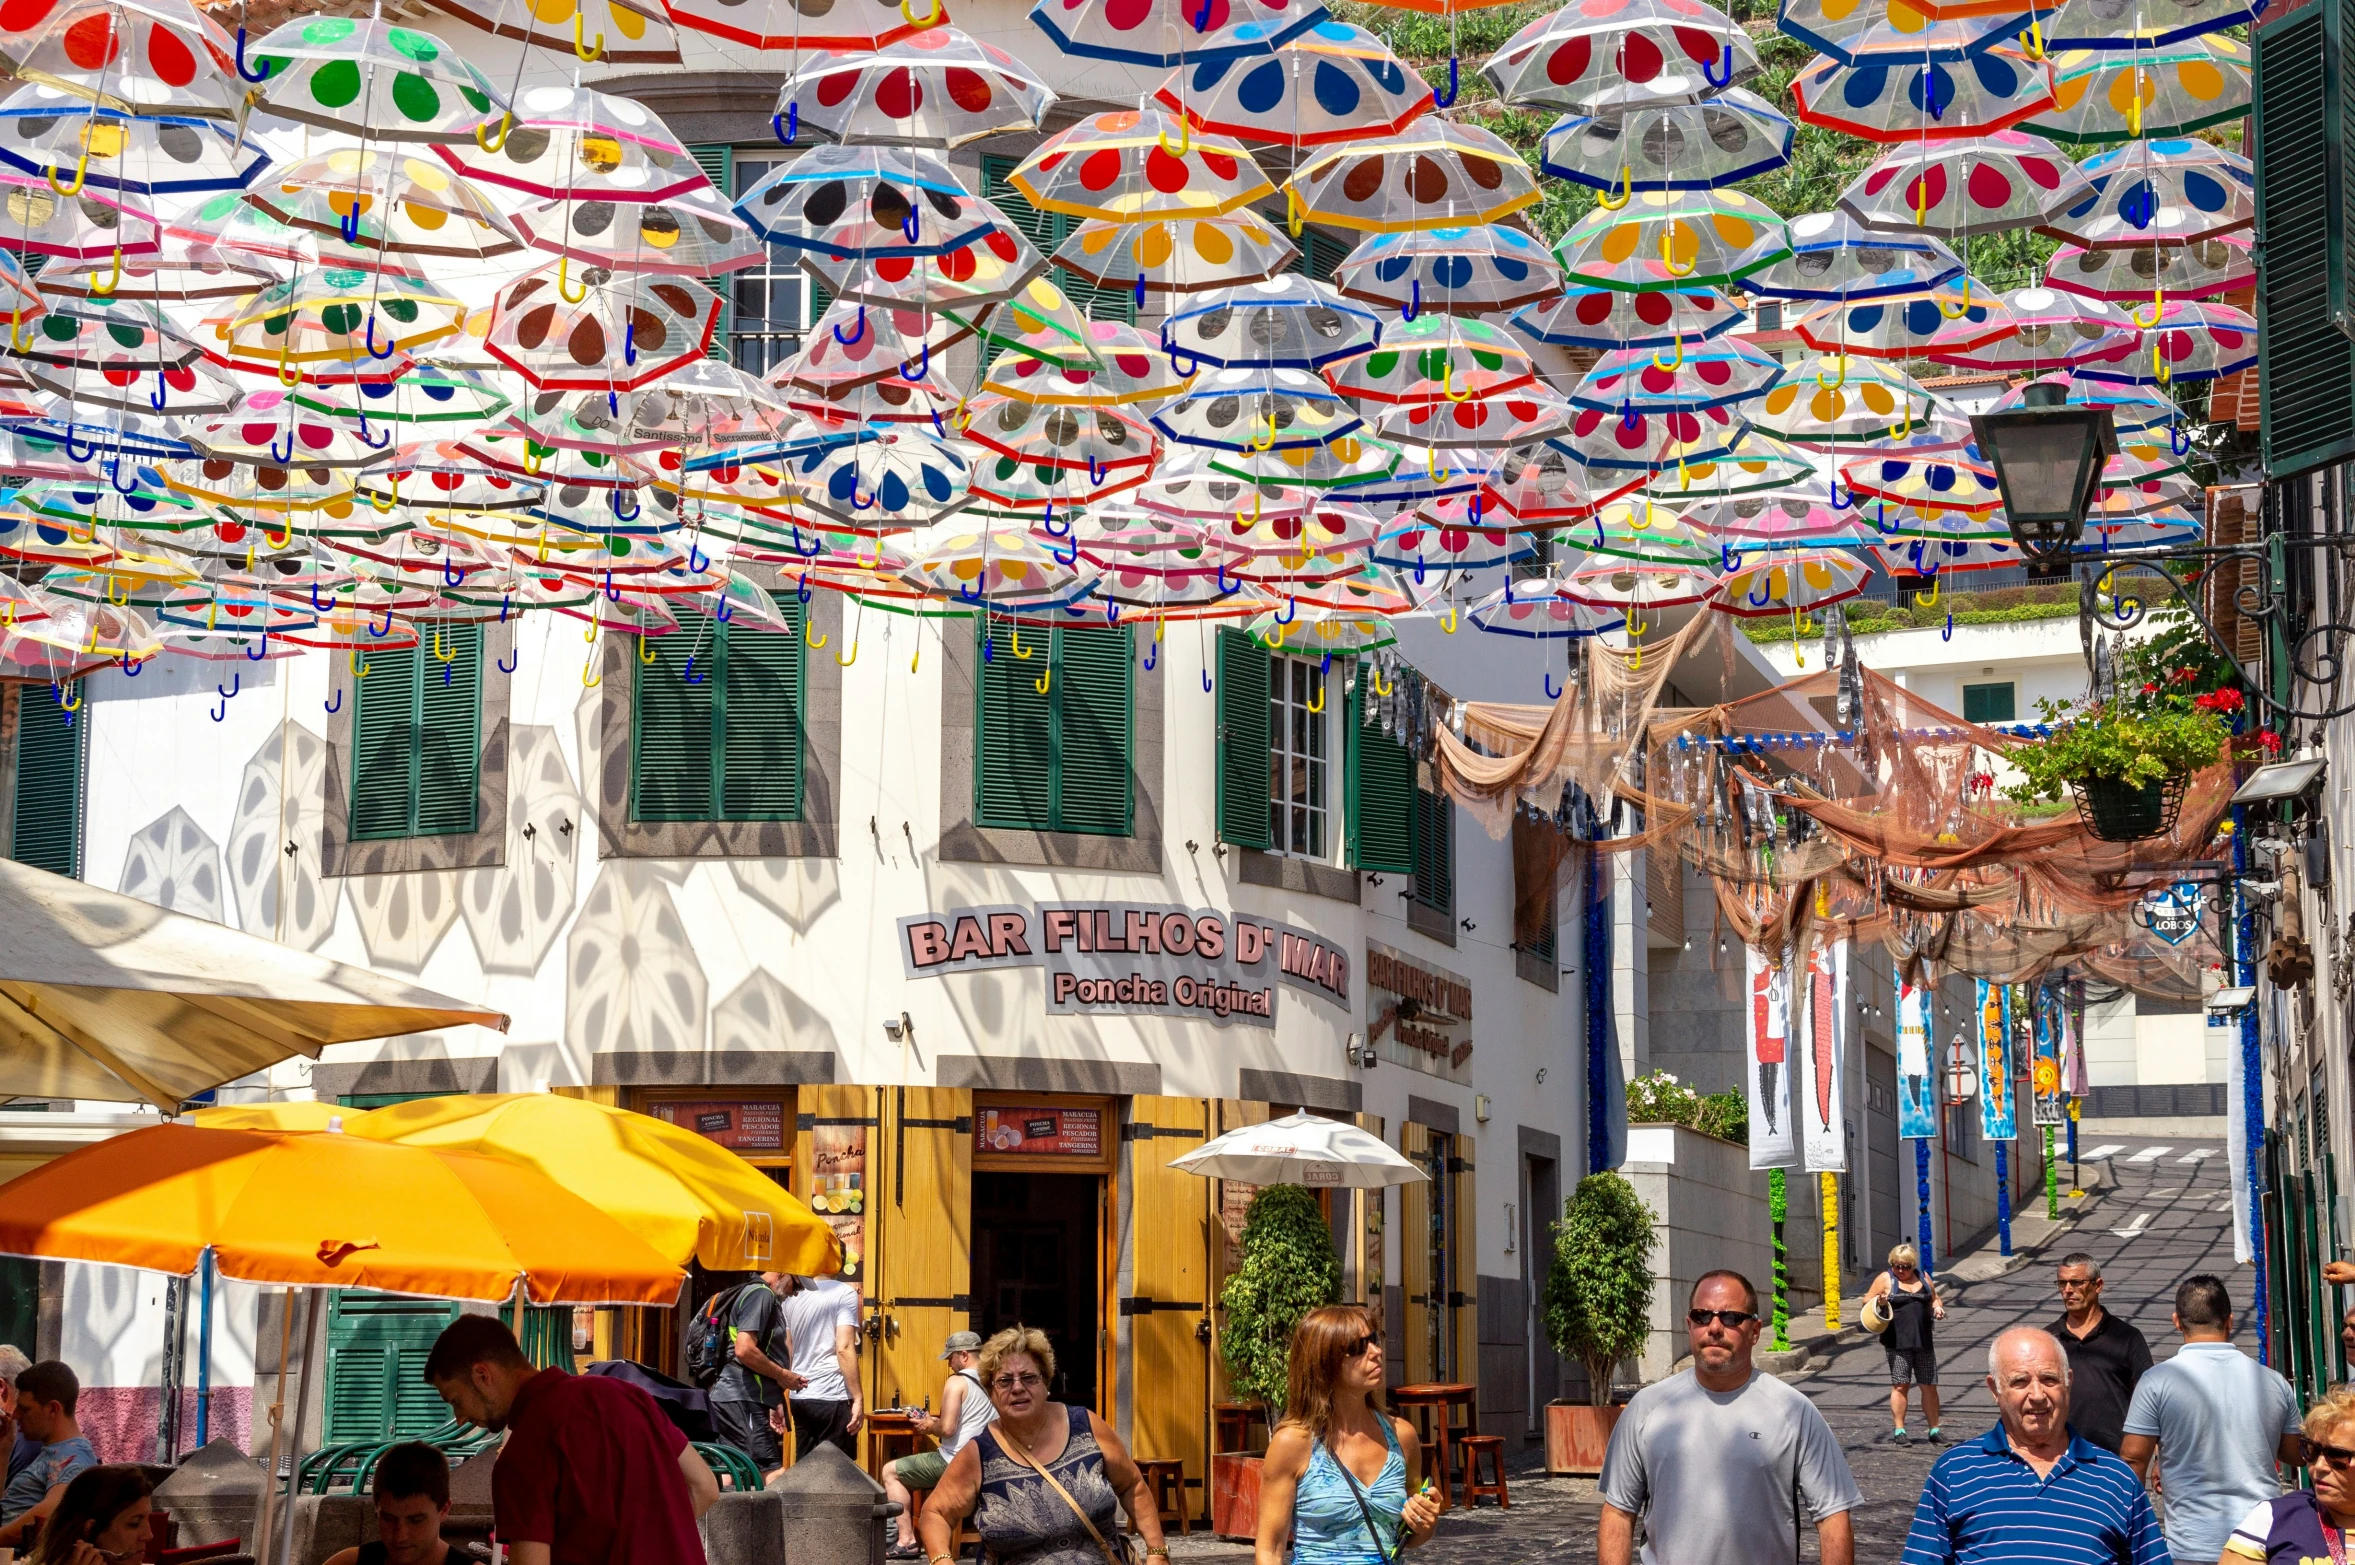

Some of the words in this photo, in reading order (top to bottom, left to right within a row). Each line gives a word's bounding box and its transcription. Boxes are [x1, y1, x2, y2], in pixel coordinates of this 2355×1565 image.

[591, 415, 610, 430] DO
[714, 431, 772, 443] Sacramento
[2156, 920, 2192, 930] LOBOS
[906, 912, 1033, 968] BAR
[1043, 910, 1225, 959] FILHOS
[1236, 921, 1274, 965] D'
[1281, 931, 1347, 1000] MAR
[1053, 972, 1170, 1005] Poncha
[1173, 975, 1271, 1019] Original
[1368, 949, 1391, 991] BAR
[1393, 960, 1434, 1006] FILHOS
[1448, 982, 1472, 1020] MAR
[816, 1144, 866, 1168] Poncha
[1257, 1146, 1292, 1154] CORAL
[748, 1229, 770, 1242] Nicola
